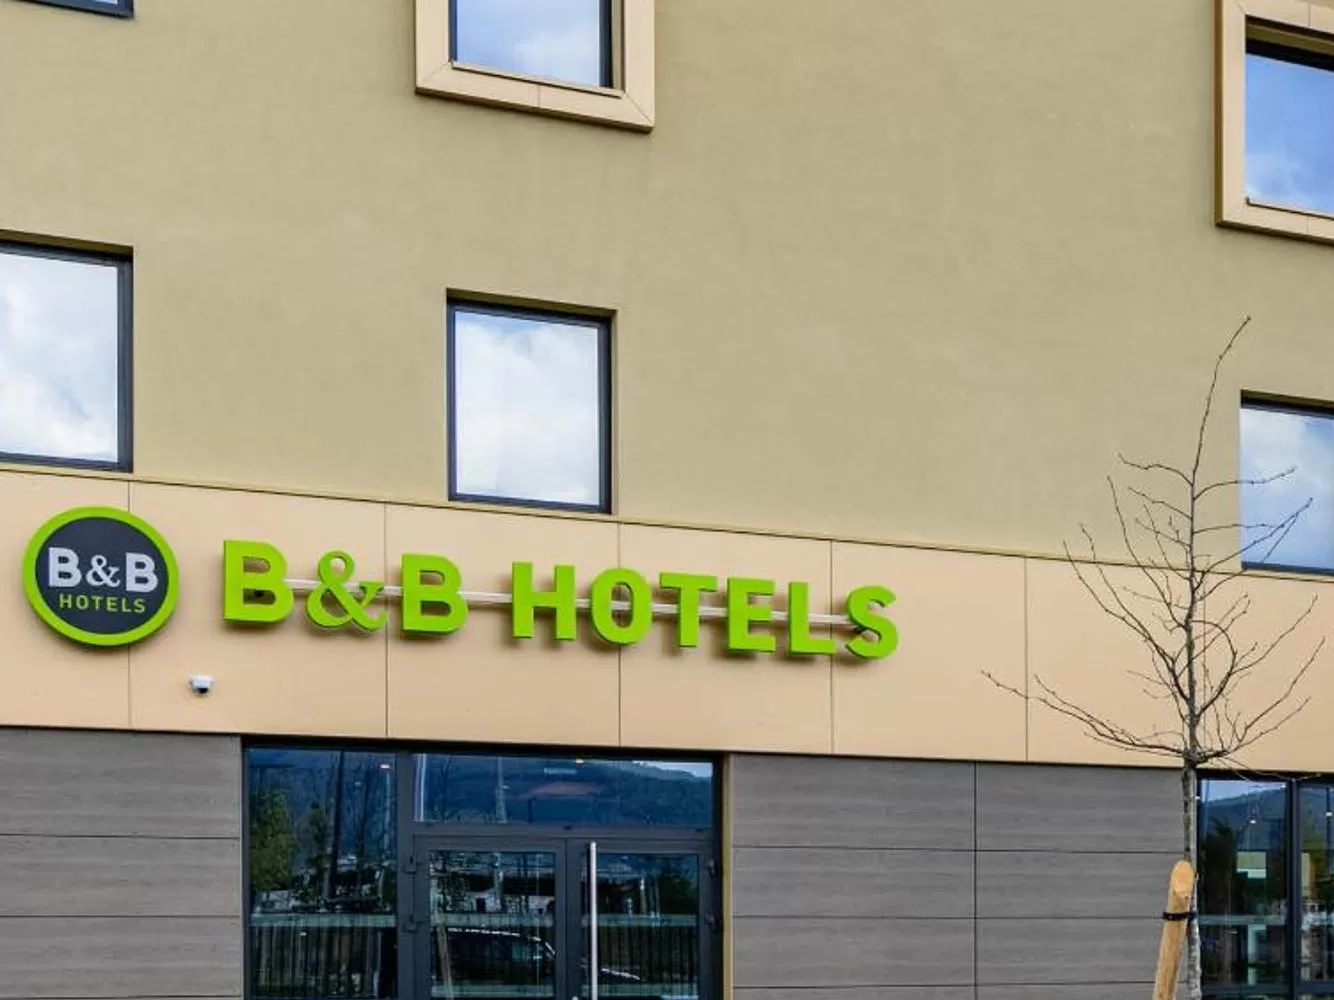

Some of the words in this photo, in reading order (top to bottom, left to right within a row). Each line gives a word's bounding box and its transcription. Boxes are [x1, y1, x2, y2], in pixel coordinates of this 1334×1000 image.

[48, 547, 159, 593] B&B
[59, 593, 147, 613] HOTELS
[223, 539, 470, 635] B&B
[511, 561, 899, 661] HOTELS
